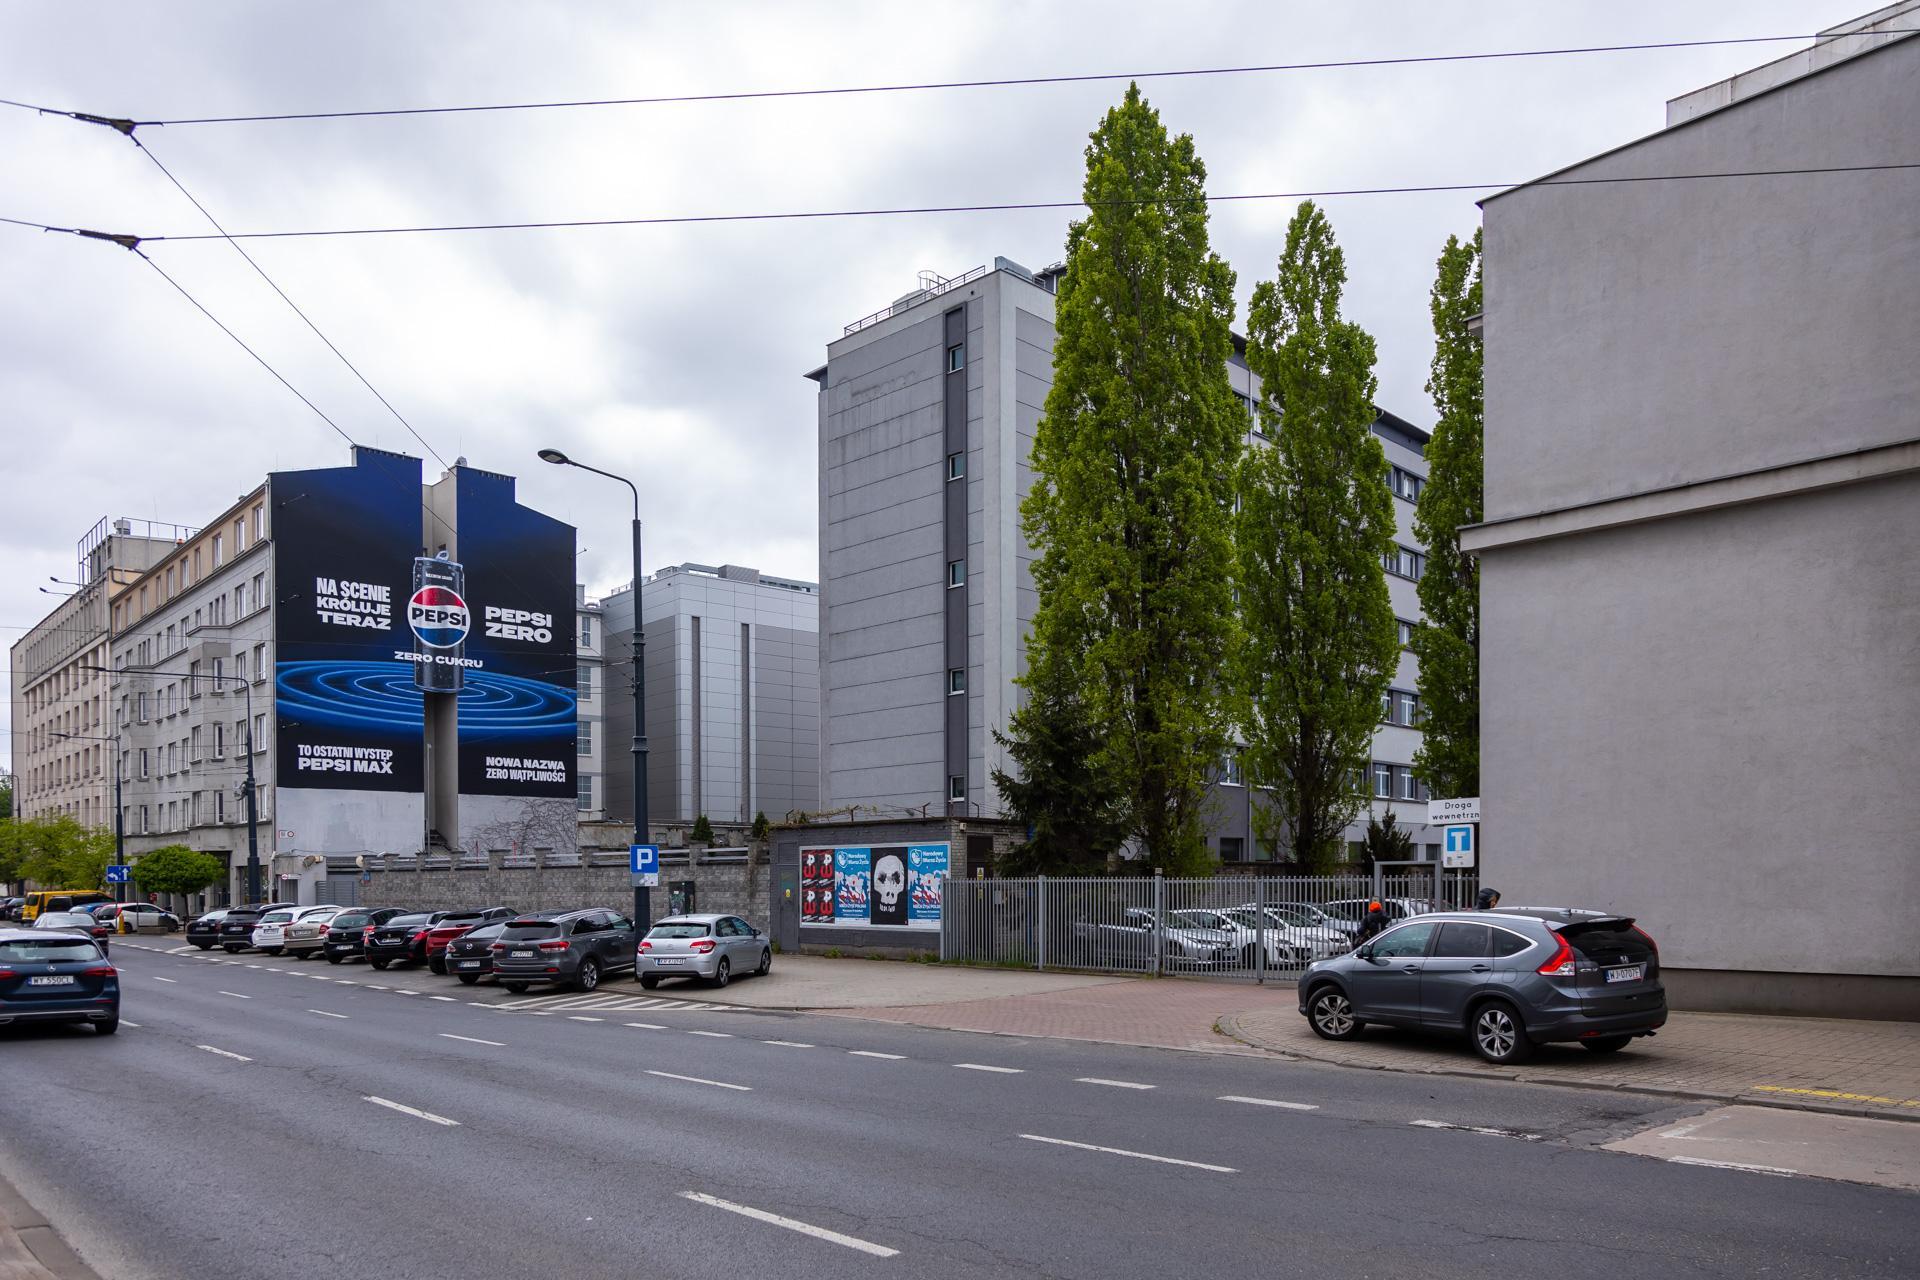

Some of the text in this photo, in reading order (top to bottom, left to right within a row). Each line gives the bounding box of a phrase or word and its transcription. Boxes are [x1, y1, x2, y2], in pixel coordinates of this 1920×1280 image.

[316, 577, 391, 603] NA SCENIE
[316, 596, 391, 616] KRÓLUJE
[316, 610, 391, 630] TERAZ
[411, 607, 467, 627] PEPSI
[485, 605, 553, 627] PEPSI
[485, 621, 553, 643] ZERO
[394, 650, 484, 668] ZERO CUKRU
[297, 744, 393, 762] TO OSTATNI WYSTĘP
[298, 757, 393, 774] PEPSI MAX
[485, 756, 566, 770] NOWA NAZWA
[485, 767, 566, 783] ZERO WĄTPLIWOŚCI
[1444, 802, 1472, 810] Droga
[1432, 812, 1480, 820] wewnętrzn
[637, 848, 653, 870] P
